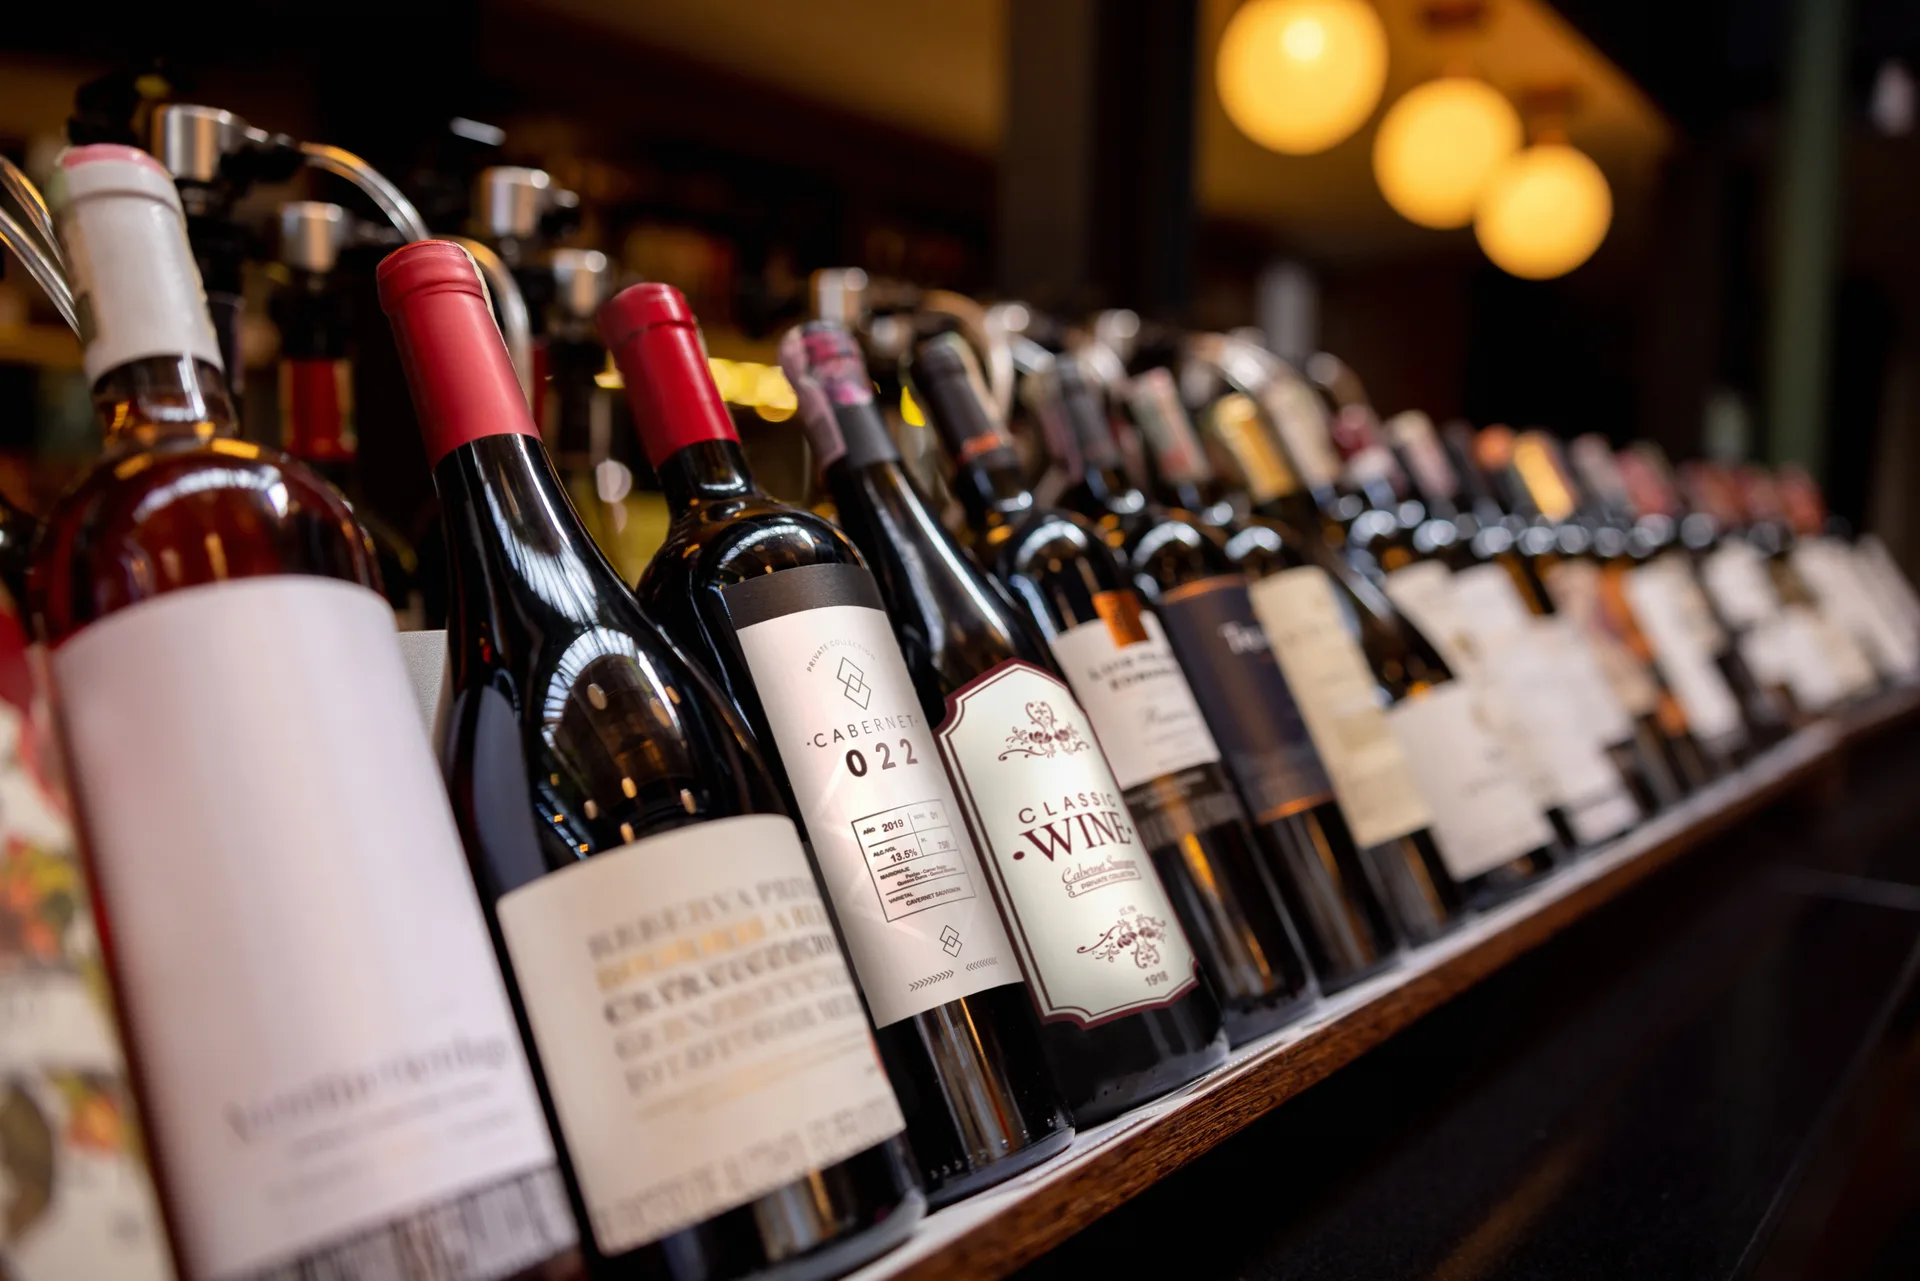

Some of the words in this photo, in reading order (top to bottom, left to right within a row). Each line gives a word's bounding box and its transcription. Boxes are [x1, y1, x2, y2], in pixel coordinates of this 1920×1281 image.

[806, 643, 829, 673] PRIVATE
[829, 639, 876, 661] COLLECTION
[813, 715, 914, 748] CABERNET
[845, 738, 919, 778] 022
[1018, 791, 1117, 824] CLASSIC
[881, 818, 904, 833] 2019
[1018, 810, 1132, 862] WINE
[890, 848, 918, 863] 13.5%
[1061, 861, 1106, 884] Cabernet
[888, 892, 914, 904] VARIETAL
[905, 892, 935, 907] CAVERNET
